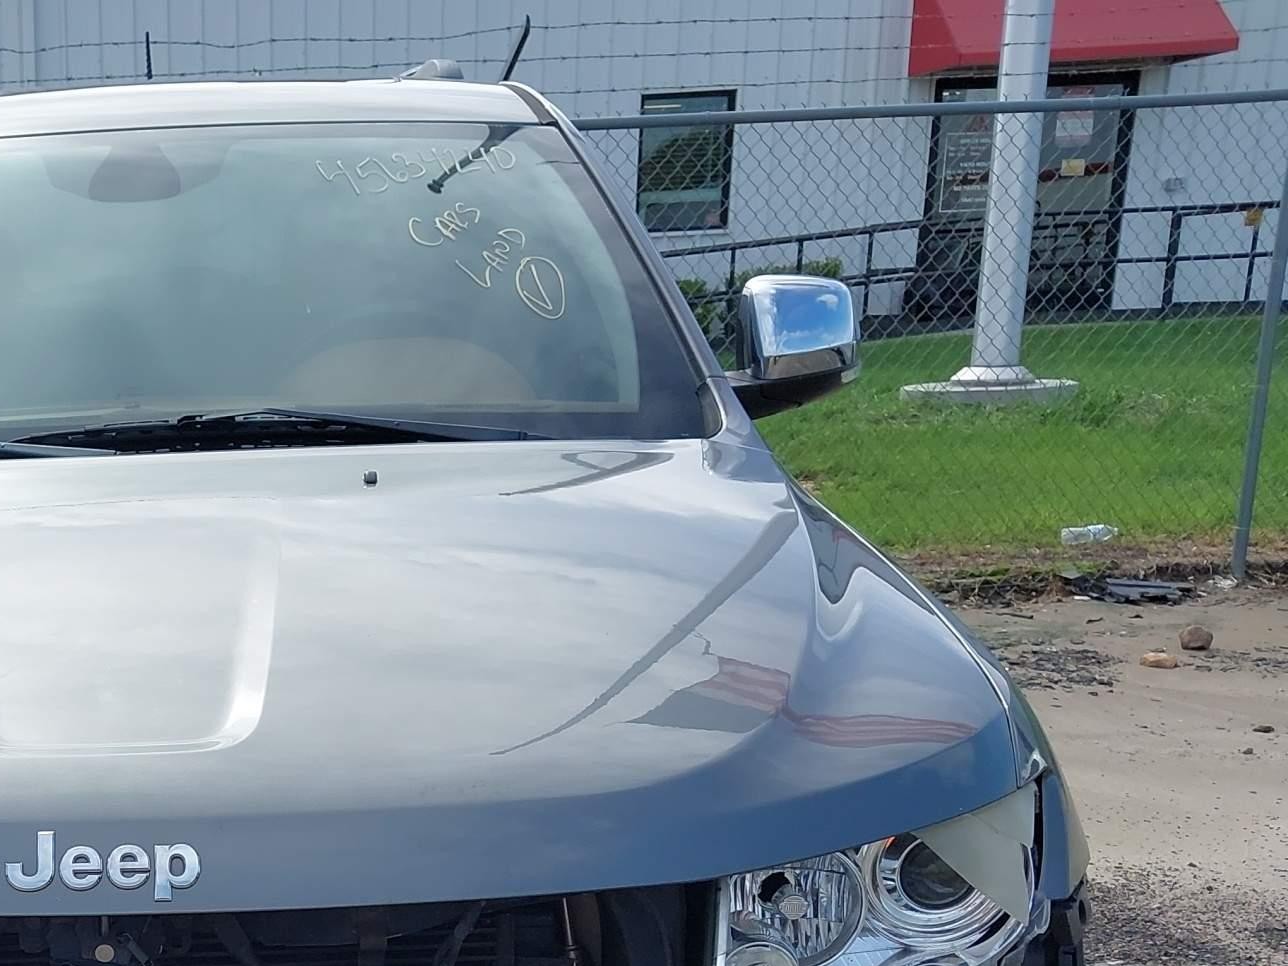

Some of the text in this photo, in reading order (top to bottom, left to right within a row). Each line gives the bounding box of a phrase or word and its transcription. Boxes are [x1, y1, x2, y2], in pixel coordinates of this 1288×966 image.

[315, 147, 516, 195] 45634240
[408, 202, 481, 246] CARS
[455, 228, 526, 288] LAND
[5, 830, 201, 902] Jeep
